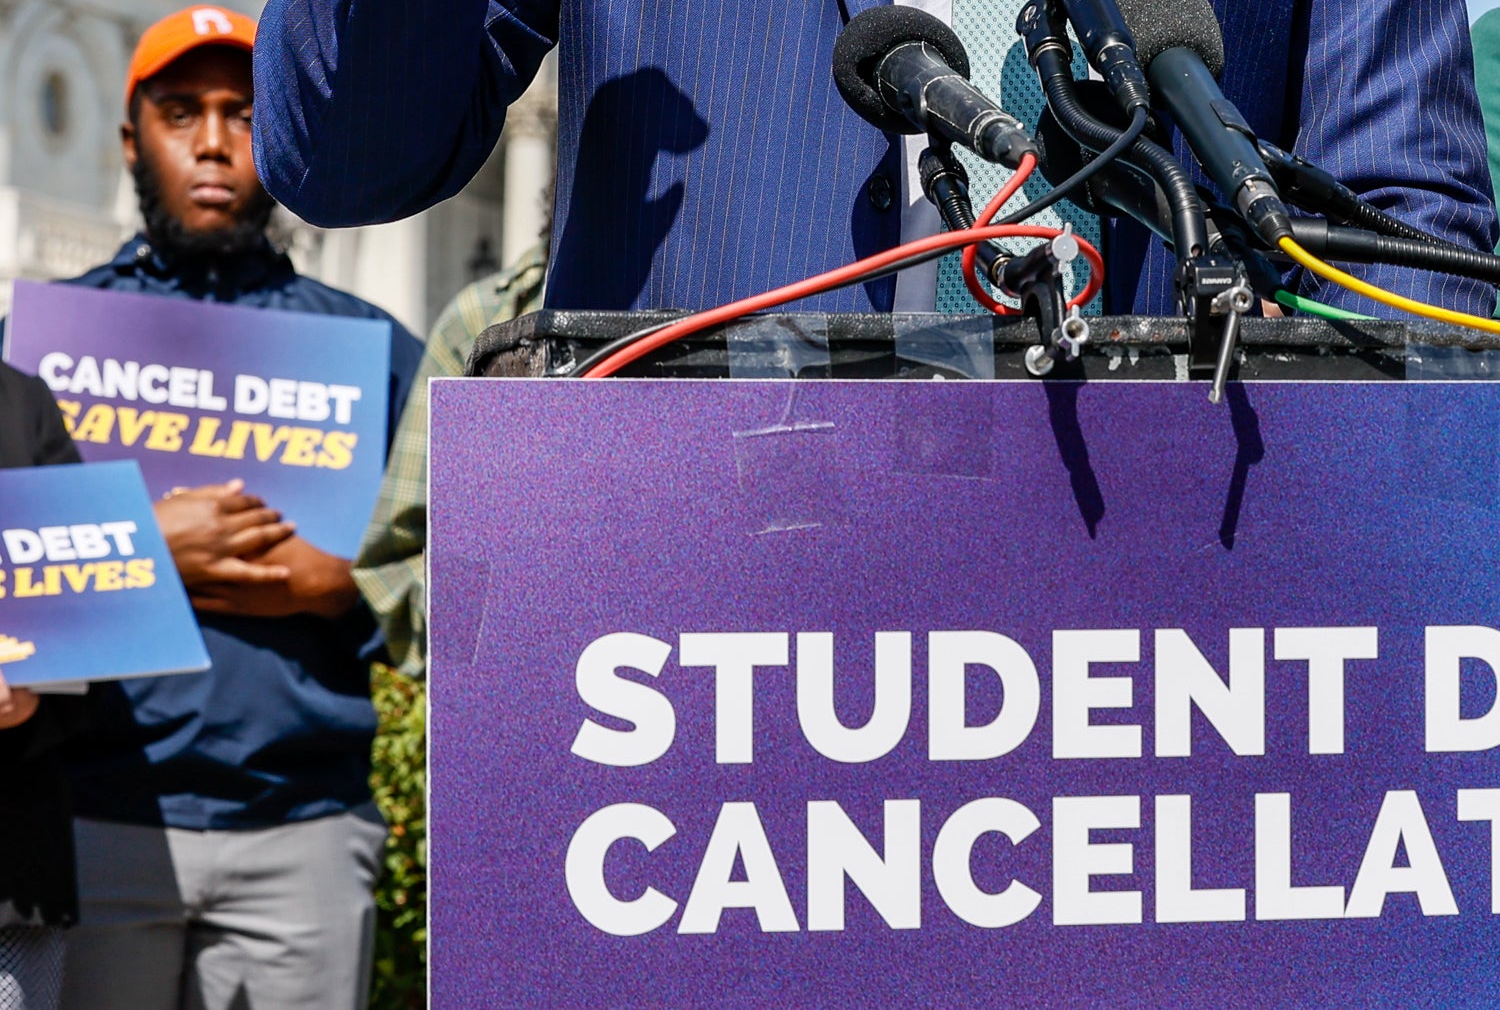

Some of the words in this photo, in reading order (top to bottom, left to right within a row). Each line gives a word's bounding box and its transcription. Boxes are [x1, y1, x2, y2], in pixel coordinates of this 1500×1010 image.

[38, 351, 228, 412] CANCEL
[233, 374, 362, 425] DEBT
[188, 416, 359, 470] LIVES
[2, 520, 138, 565] DEBT
[13, 557, 156, 598] LIVES
[571, 627, 1377, 766] STUDENT
